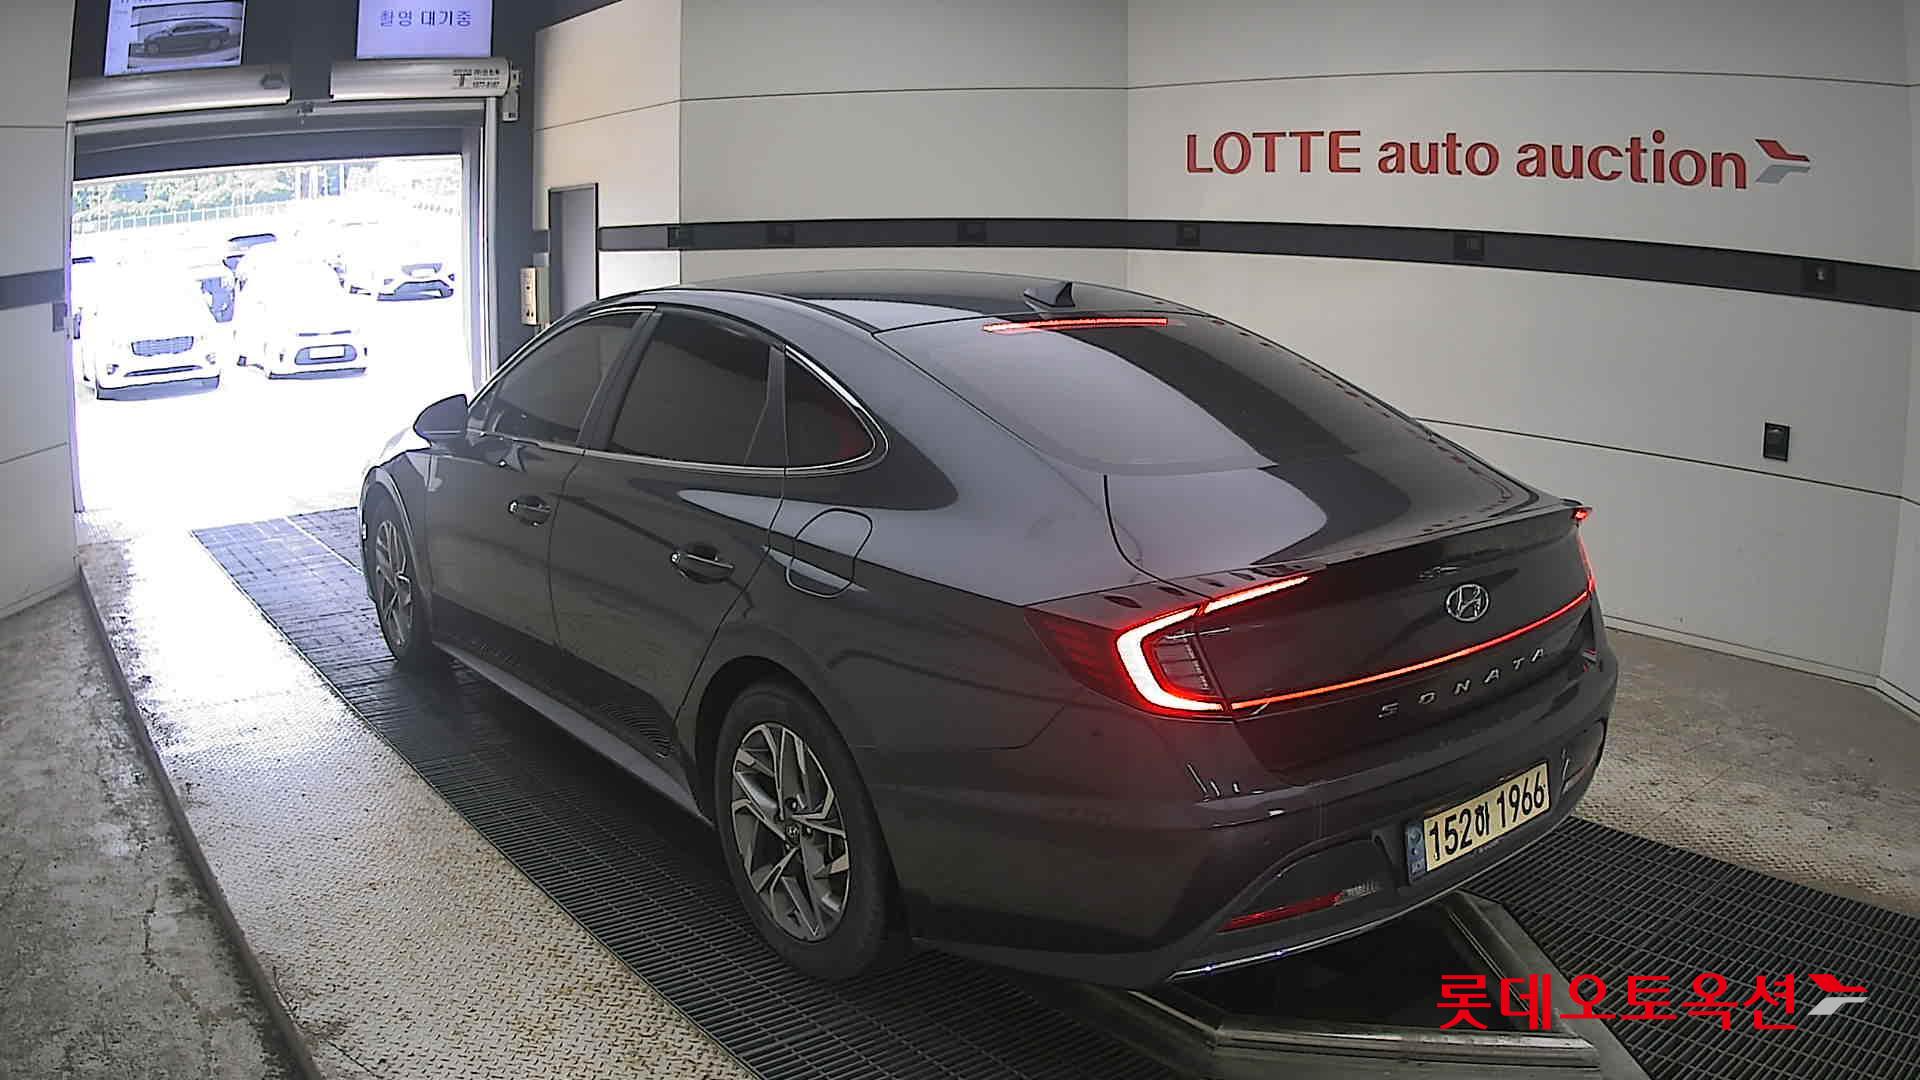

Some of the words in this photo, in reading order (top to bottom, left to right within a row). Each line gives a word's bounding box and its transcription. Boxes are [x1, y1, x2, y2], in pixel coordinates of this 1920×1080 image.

[420, 9, 472, 28] 대기중
[1186, 130, 1361, 174] LOTTE
[1377, 132, 1500, 176] auto
[1515, 130, 1748, 190] auction
[1377, 646, 1546, 719] SONATA
[1496, 770, 1546, 829] 1966
